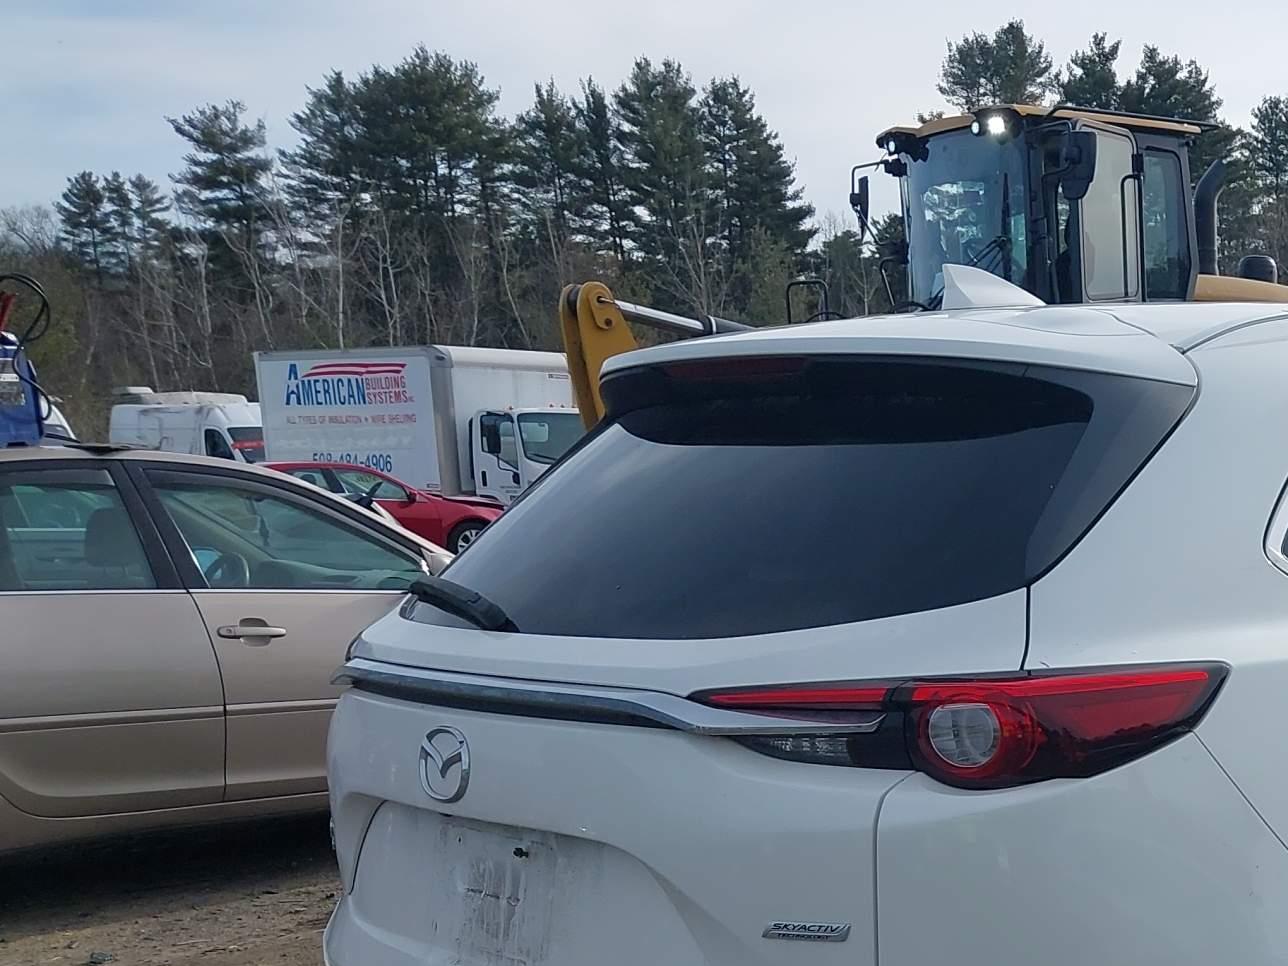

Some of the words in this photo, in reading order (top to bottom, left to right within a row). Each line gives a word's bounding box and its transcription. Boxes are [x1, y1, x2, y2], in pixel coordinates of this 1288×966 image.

[285, 363, 367, 405] AMERICAN
[366, 375, 406, 390] BUILDING
[367, 390, 408, 405] SYSTEMS
[771, 922, 841, 933] SKYACTIV
